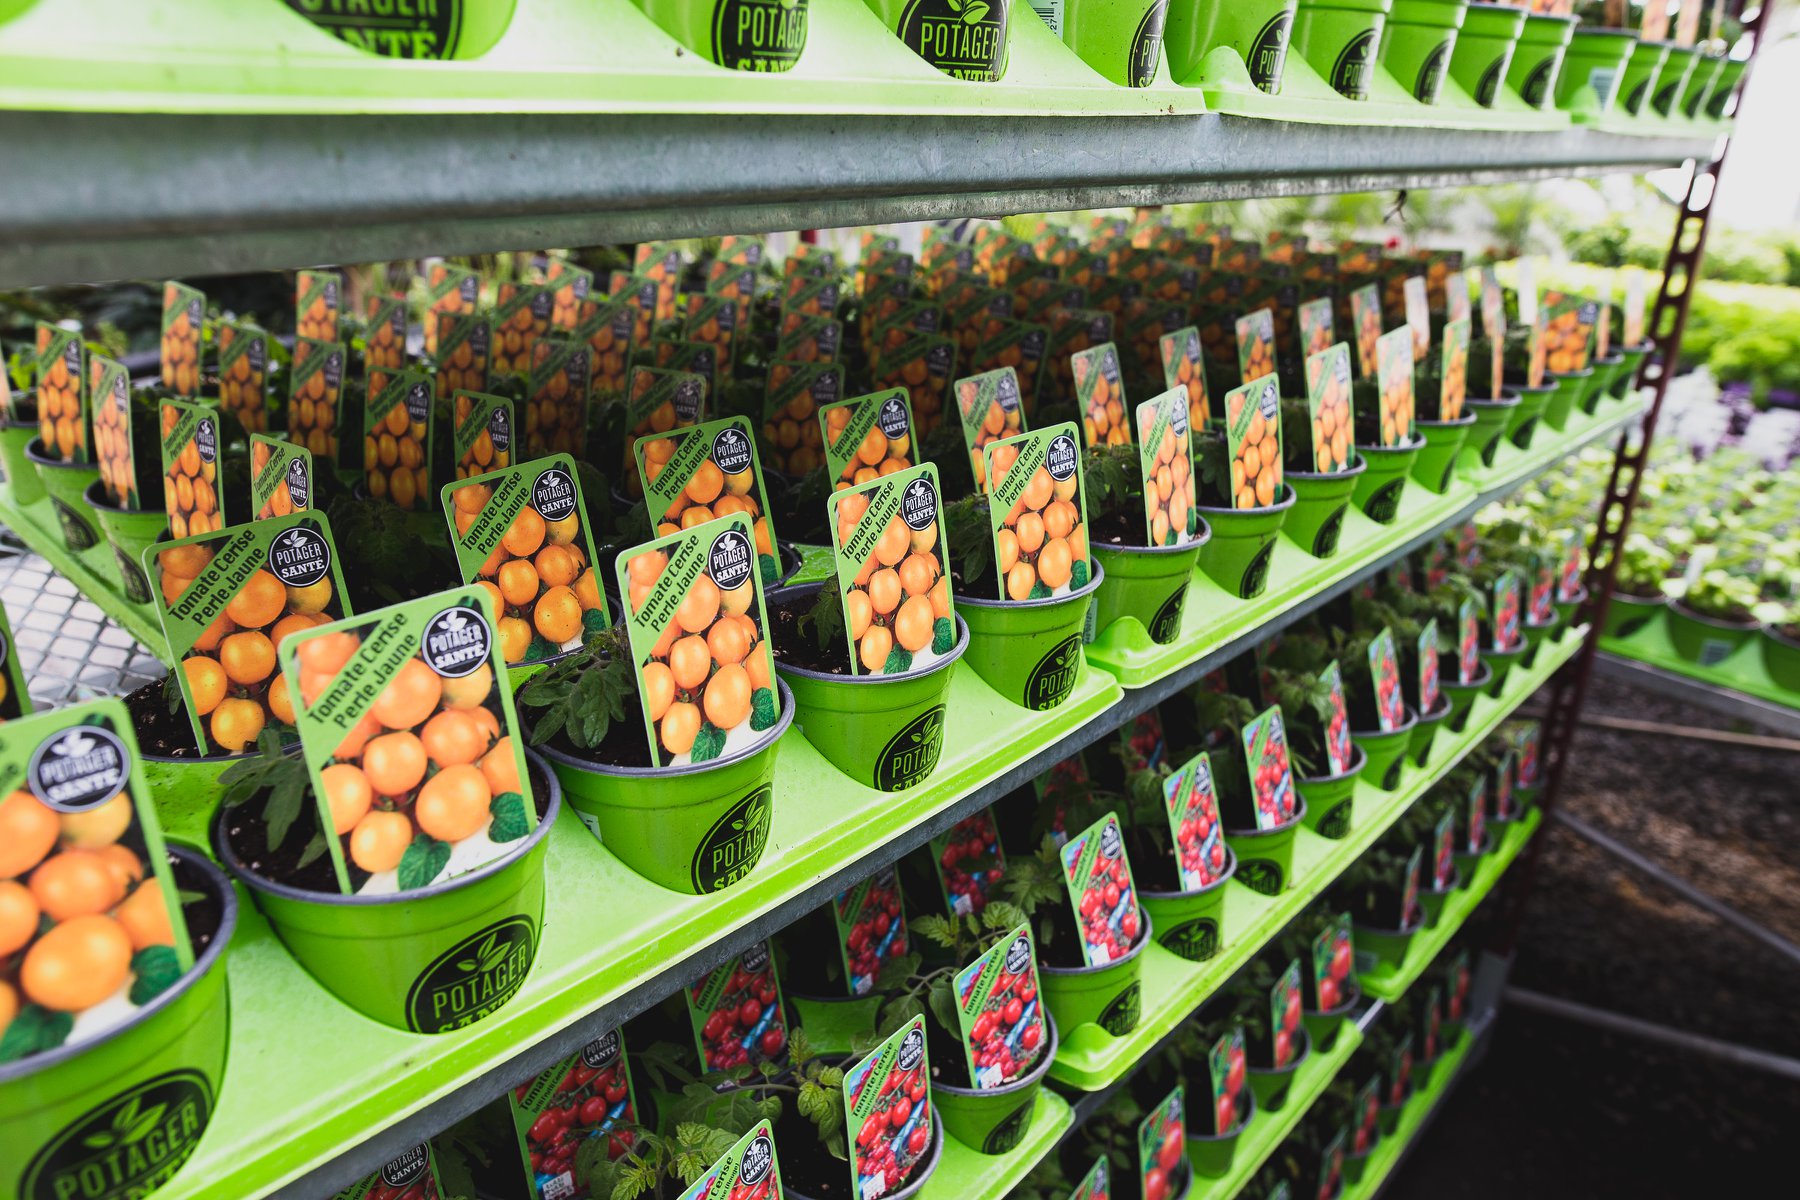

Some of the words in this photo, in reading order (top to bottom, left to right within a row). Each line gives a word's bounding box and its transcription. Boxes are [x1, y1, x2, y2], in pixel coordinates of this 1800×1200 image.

[920, 22, 1000, 60] POTAGER
[717, 441, 747, 457] POTAGER
[830, 425, 856, 457] Tomate
[852, 398, 873, 425] Cerise
[841, 437, 860, 462] Perle
[859, 411, 878, 439] Jaune
[649, 461, 681, 496] Tomate
[678, 428, 704, 460] Cerise
[664, 473, 688, 501] Perle
[686, 442, 710, 474] Jaune
[720, 452, 748, 467] SANTÉ
[994, 464, 1022, 502] Tomate
[1018, 436, 1040, 467] Cerise
[1004, 479, 1025, 507] Perle
[1024, 449, 1045, 481] Jaune
[461, 506, 498, 551] Tomate
[492, 471, 523, 506] Cerise
[537, 482, 571, 502] POTAGER
[541, 495, 573, 514] SANTÉ
[905, 492, 933, 513] POTAGER
[908, 504, 934, 523] SANTÉ
[477, 523, 505, 555] Perle
[502, 486, 529, 524] Jaune
[840, 516, 873, 560] Tomate
[868, 481, 895, 517] Cerise
[854, 532, 878, 564] Perle
[877, 496, 900, 533] Jaune
[168, 569, 221, 620] Tomate
[215, 528, 256, 570] Cerise
[276, 543, 322, 566] POTAGER
[281, 558, 325, 578] SANTÉ
[713, 546, 747, 570] POTAGER
[716, 560, 749, 582] SANTÉ
[192, 586, 230, 626] Perle
[227, 548, 265, 589] Jaune
[634, 576, 673, 628] Tomate
[667, 534, 699, 577] Cerise
[650, 595, 679, 633] Perle
[678, 552, 705, 595] Jaune
[429, 624, 483, 654] POTAGER
[434, 642, 485, 669] SANTÉ
[307, 662, 366, 724] Tomate
[360, 612, 409, 663] Cerise
[333, 683, 375, 729] Perle
[376, 633, 418, 685] Jaune
[433, 944, 527, 1019] POTAGER
[520, 1066, 552, 1111] Tomate
[853, 1076, 876, 1117] Tomate
[874, 1042, 893, 1076] Cerise
[53, 1101, 199, 1200] POTAGER
[387, 1146, 422, 1174] POTAGER
[391, 1158, 425, 1183] SANTÉ
[743, 1144, 769, 1173] POTAGER
[711, 1156, 734, 1197] Cerise
